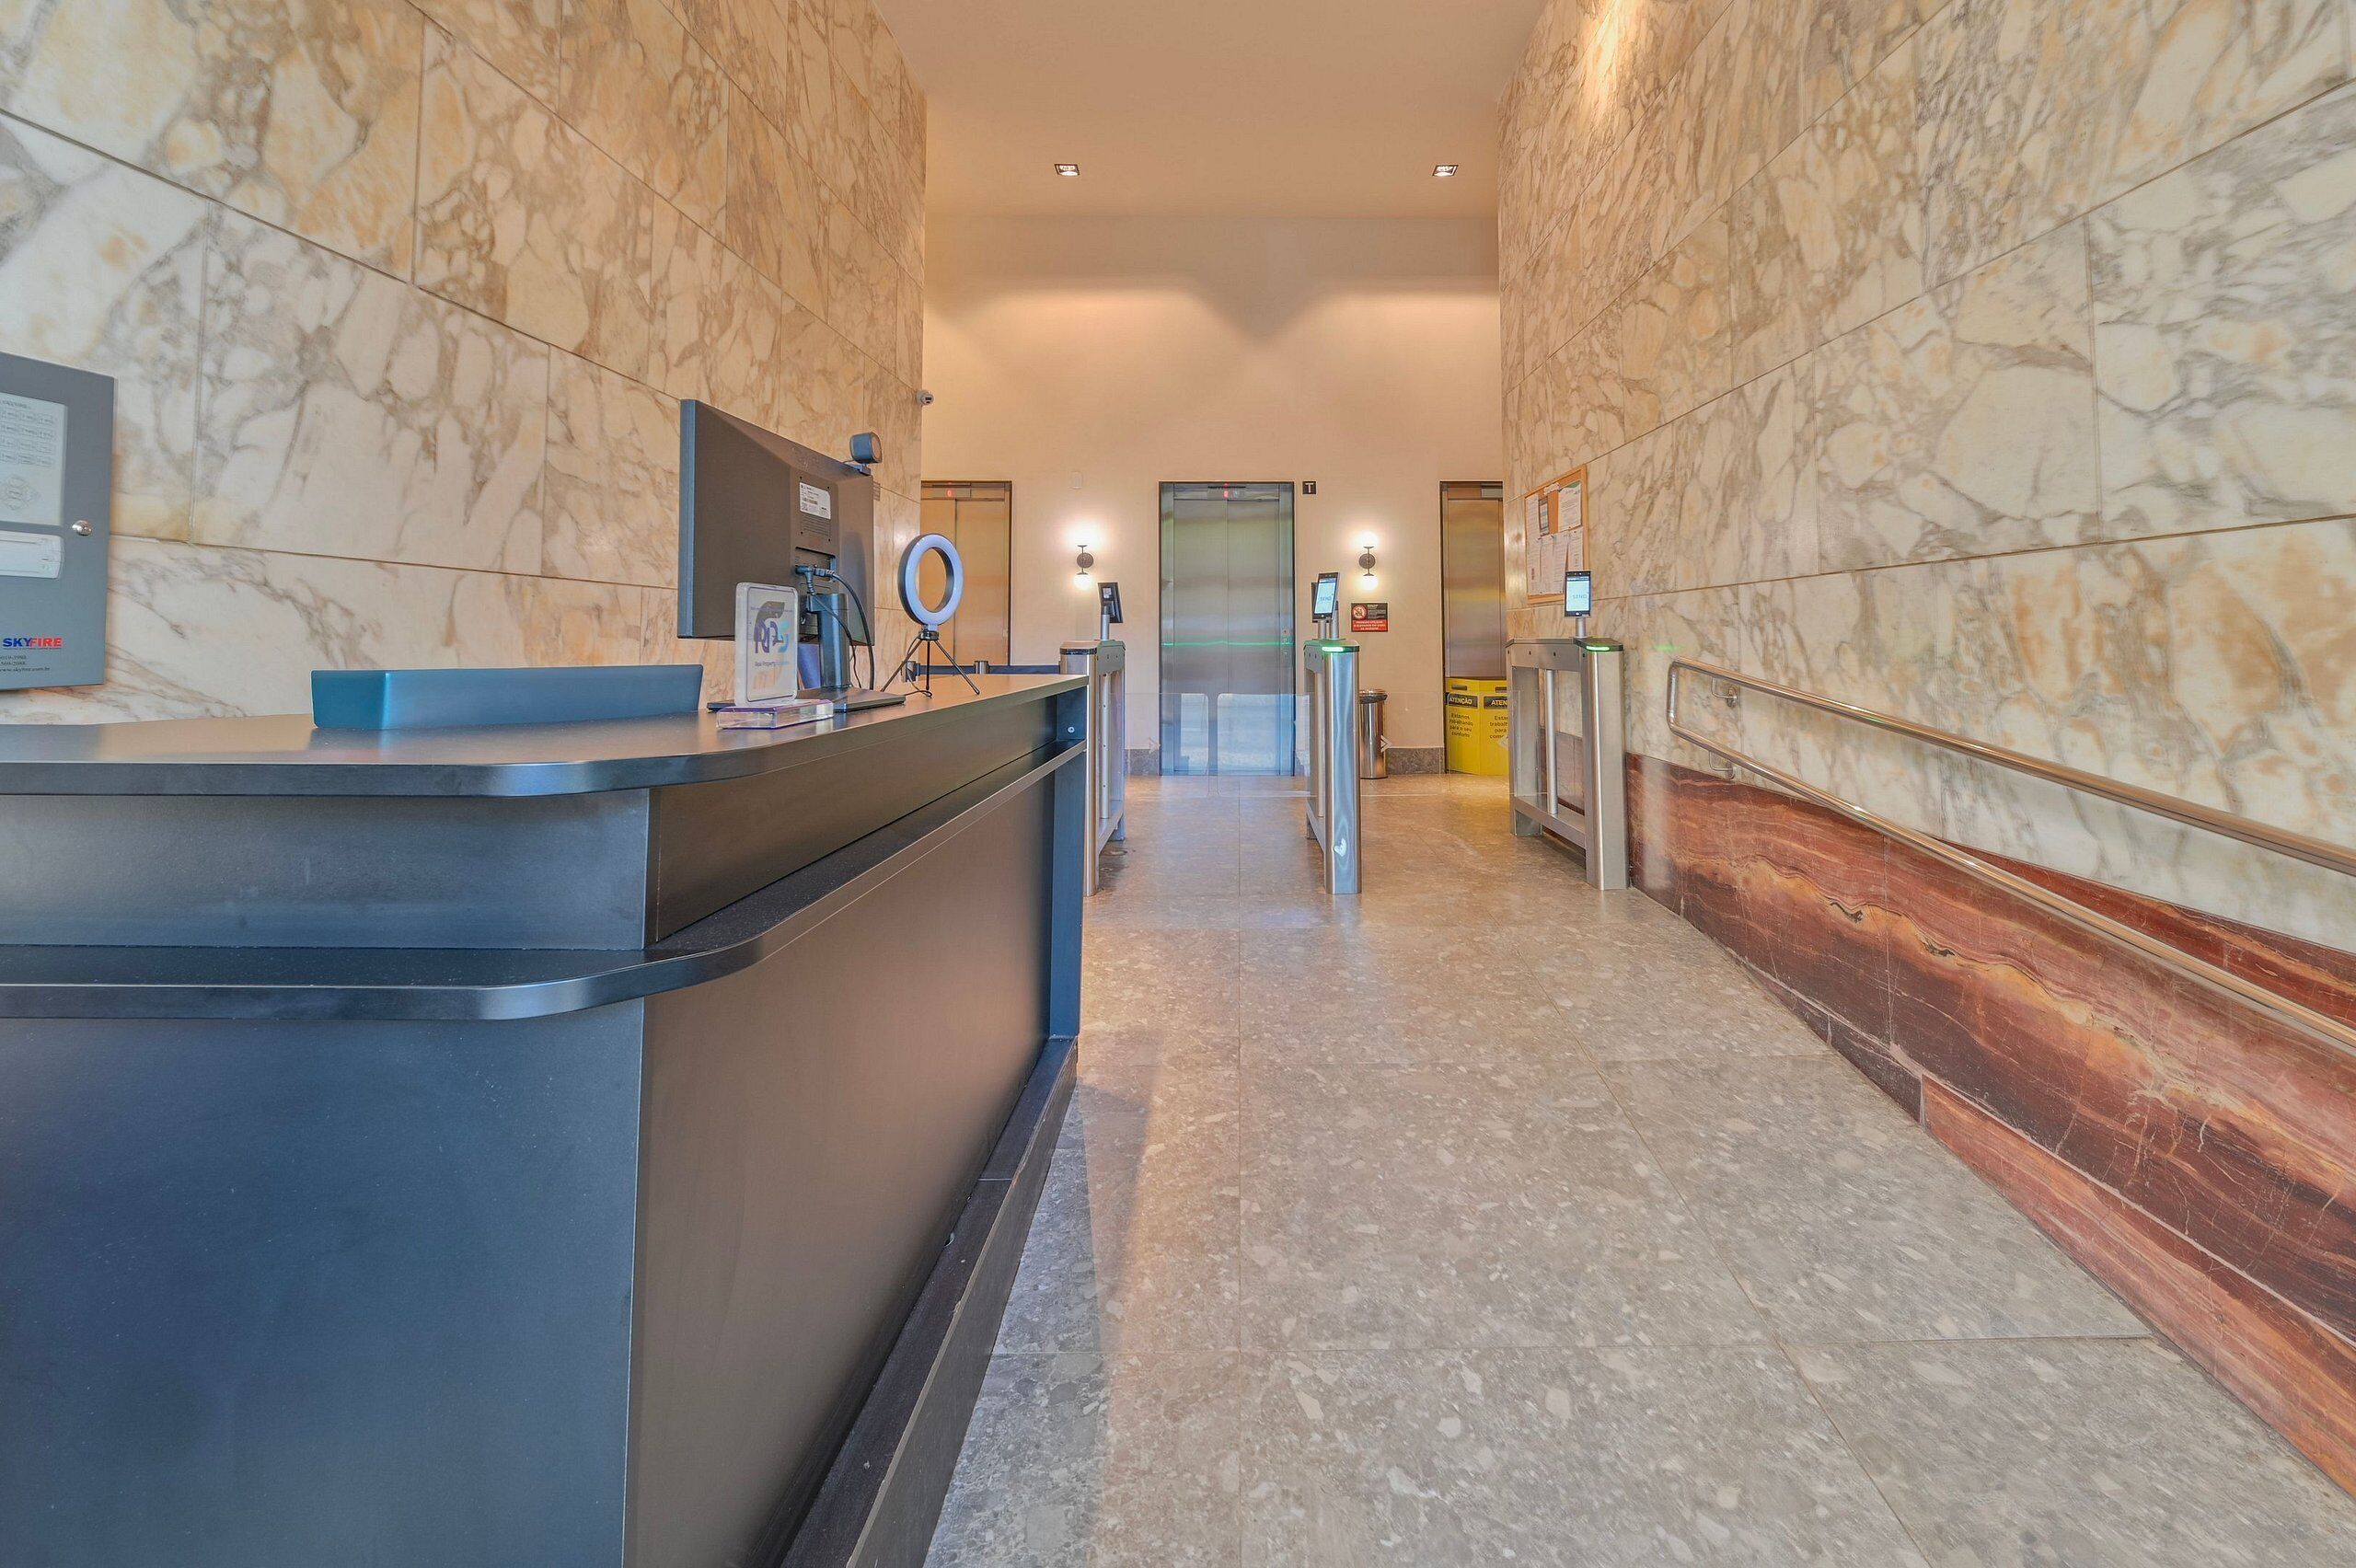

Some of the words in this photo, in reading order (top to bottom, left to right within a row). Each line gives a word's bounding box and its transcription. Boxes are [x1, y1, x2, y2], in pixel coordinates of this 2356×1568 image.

[1305, 483, 1313, 493] T
[3, 637, 63, 647] SKYFIRE
[1449, 697, 1472, 705] ATENÇÃO
